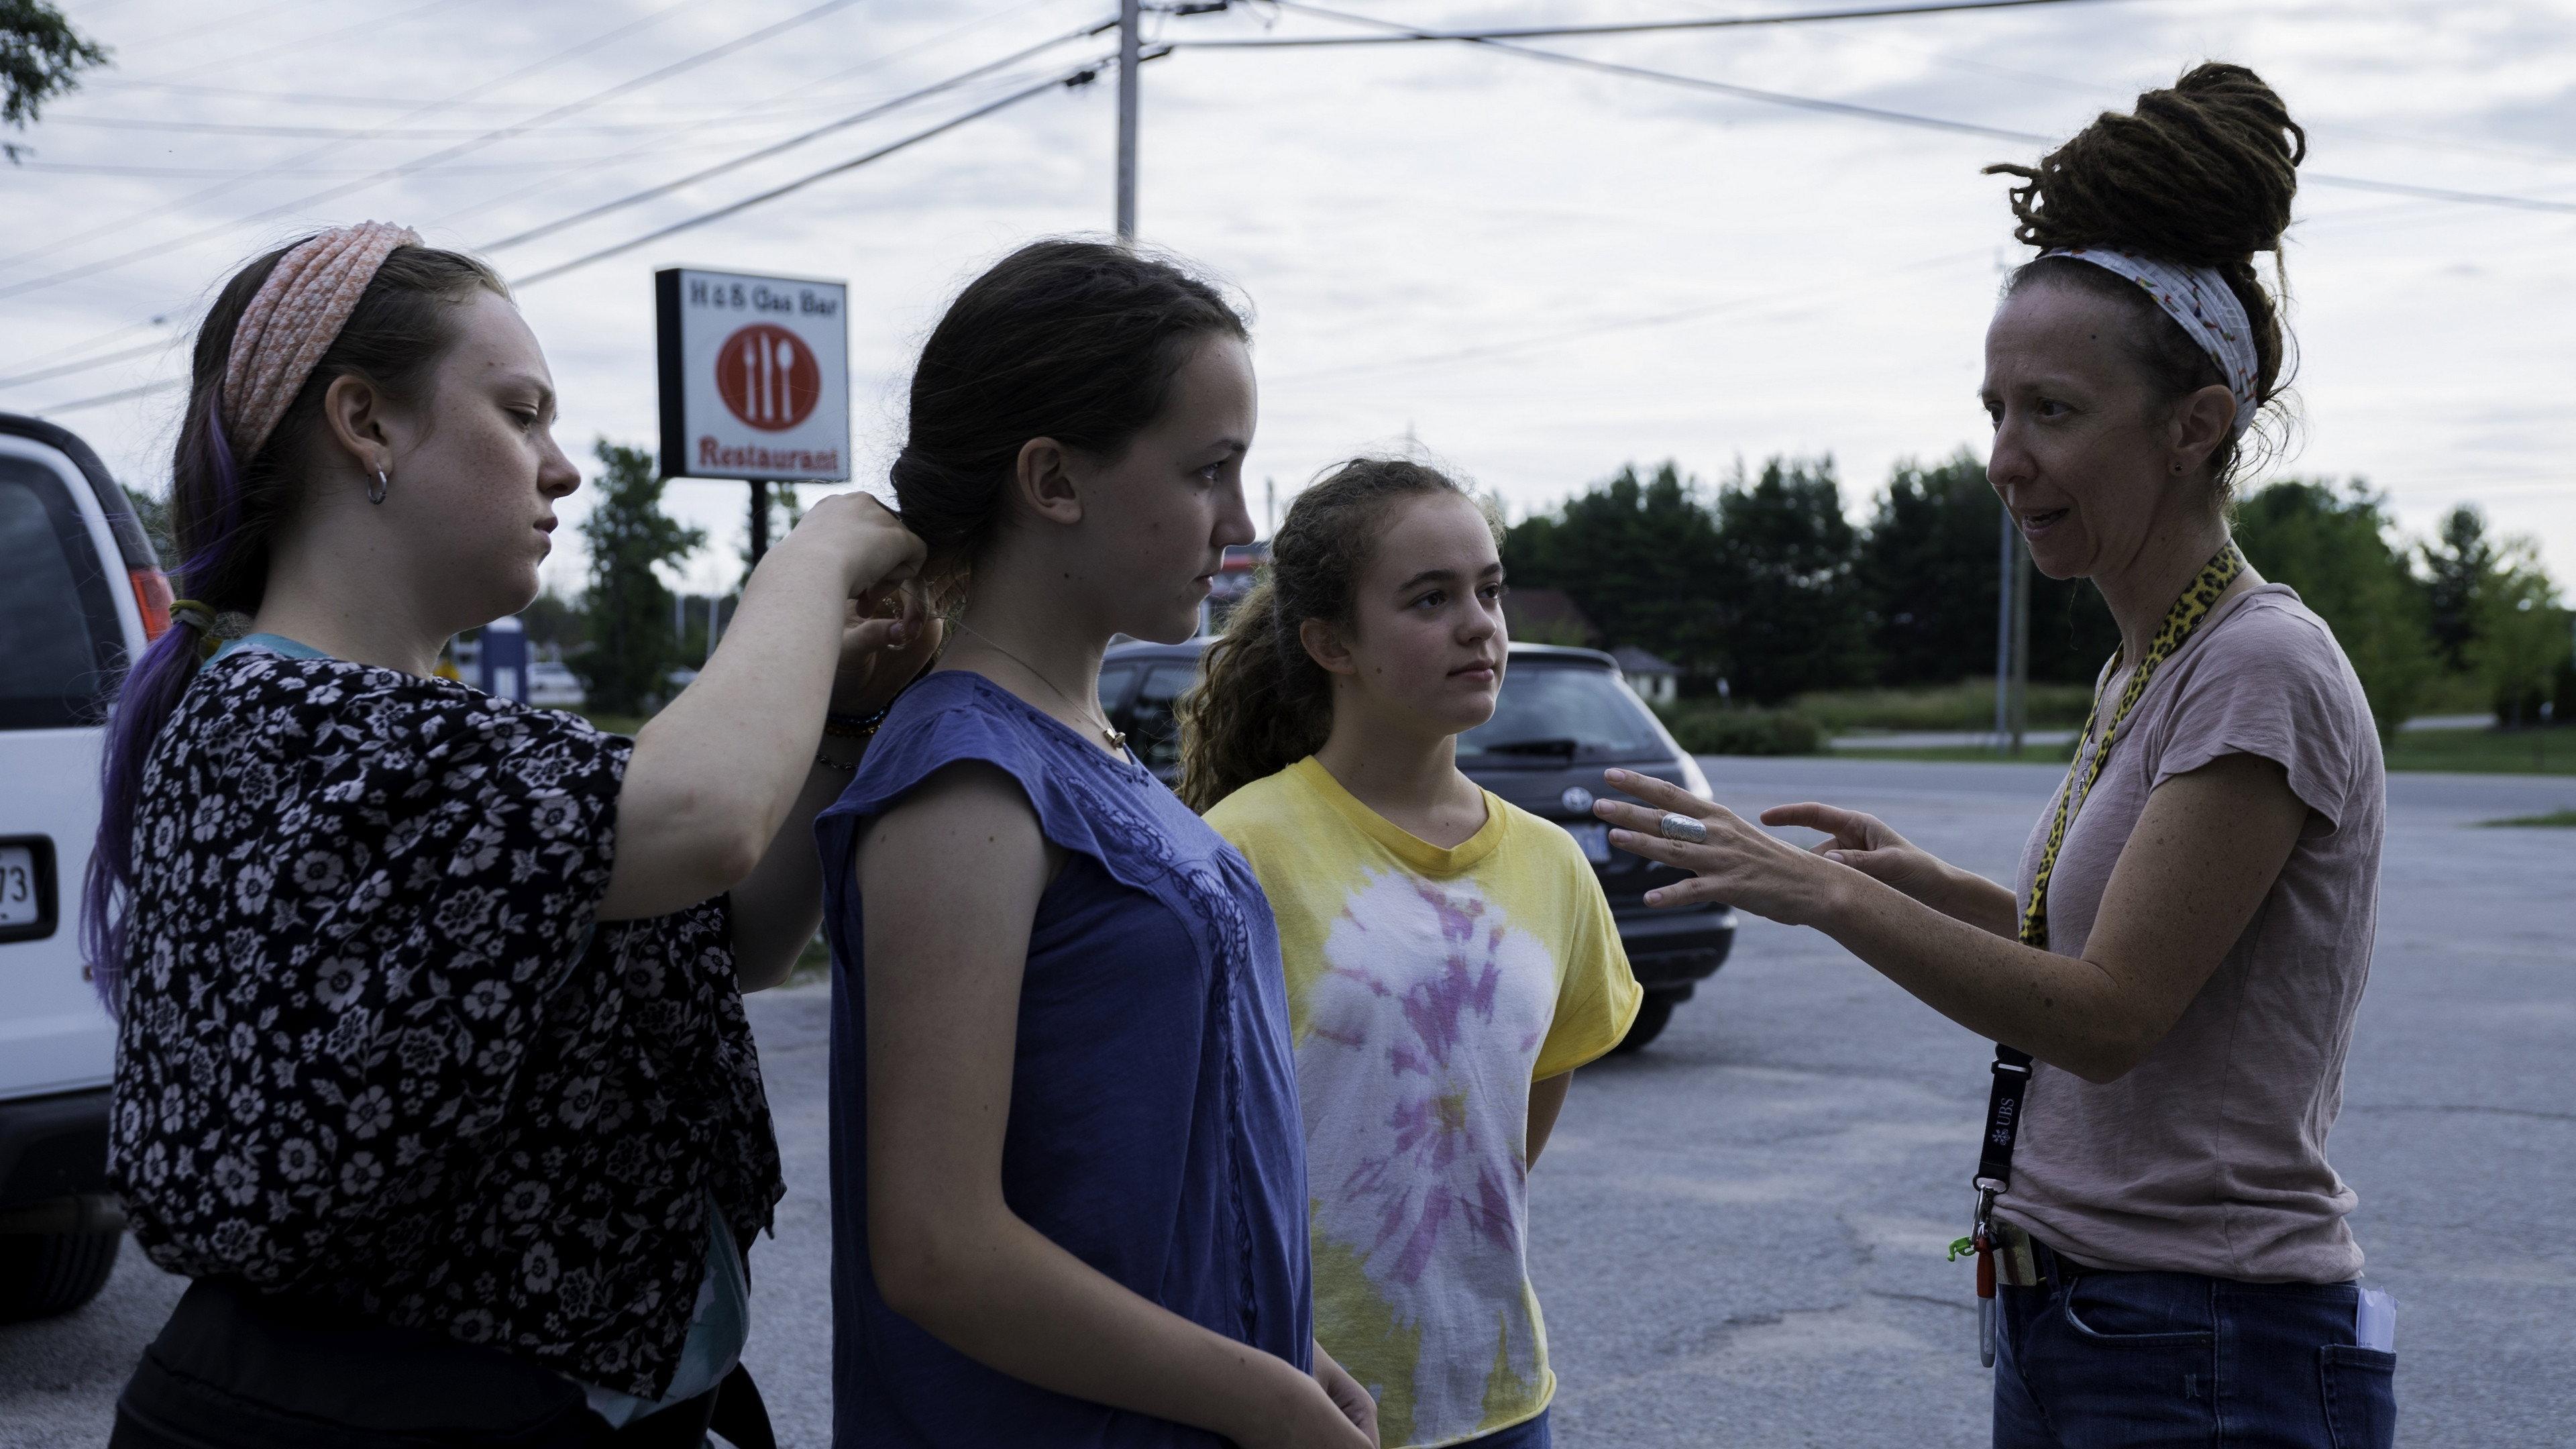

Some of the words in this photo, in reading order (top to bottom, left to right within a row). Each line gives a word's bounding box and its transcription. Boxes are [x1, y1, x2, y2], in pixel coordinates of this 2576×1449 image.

[690, 280, 708, 305] H
[752, 285, 793, 311] Gas
[800, 289, 837, 314] Bar
[698, 435, 838, 470] Restaurant
[1996, 1097, 2015, 1126] UBS
